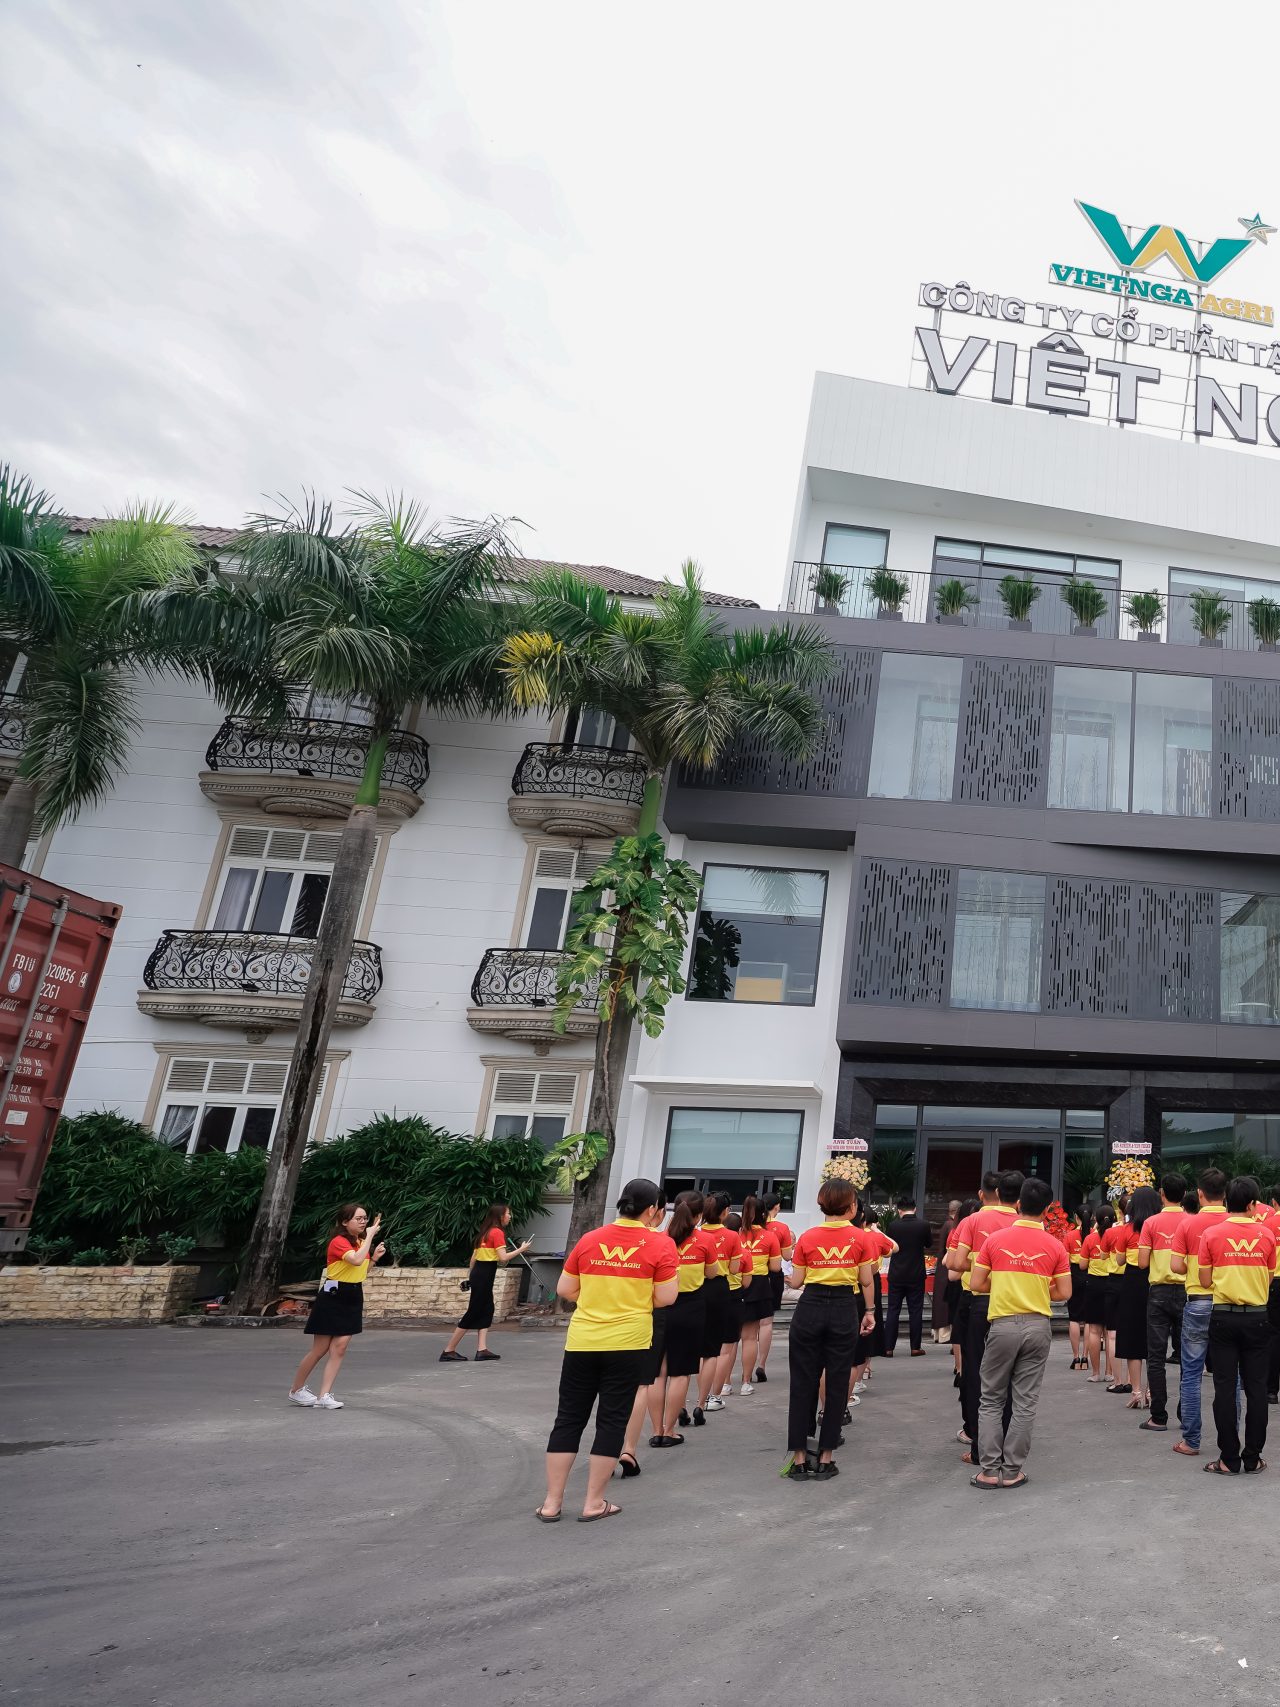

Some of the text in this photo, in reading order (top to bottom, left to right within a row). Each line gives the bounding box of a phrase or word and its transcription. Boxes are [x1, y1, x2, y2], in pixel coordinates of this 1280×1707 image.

[923, 280, 1025, 324] CÔNG
[1036, 302, 1083, 332] TY
[1091, 307, 1140, 343] CỔ
[1149, 323, 1239, 361] PHẦN
[1051, 263, 1274, 326] VIETNGA AGRI
[590, 1259, 622, 1268] VIETNGA
